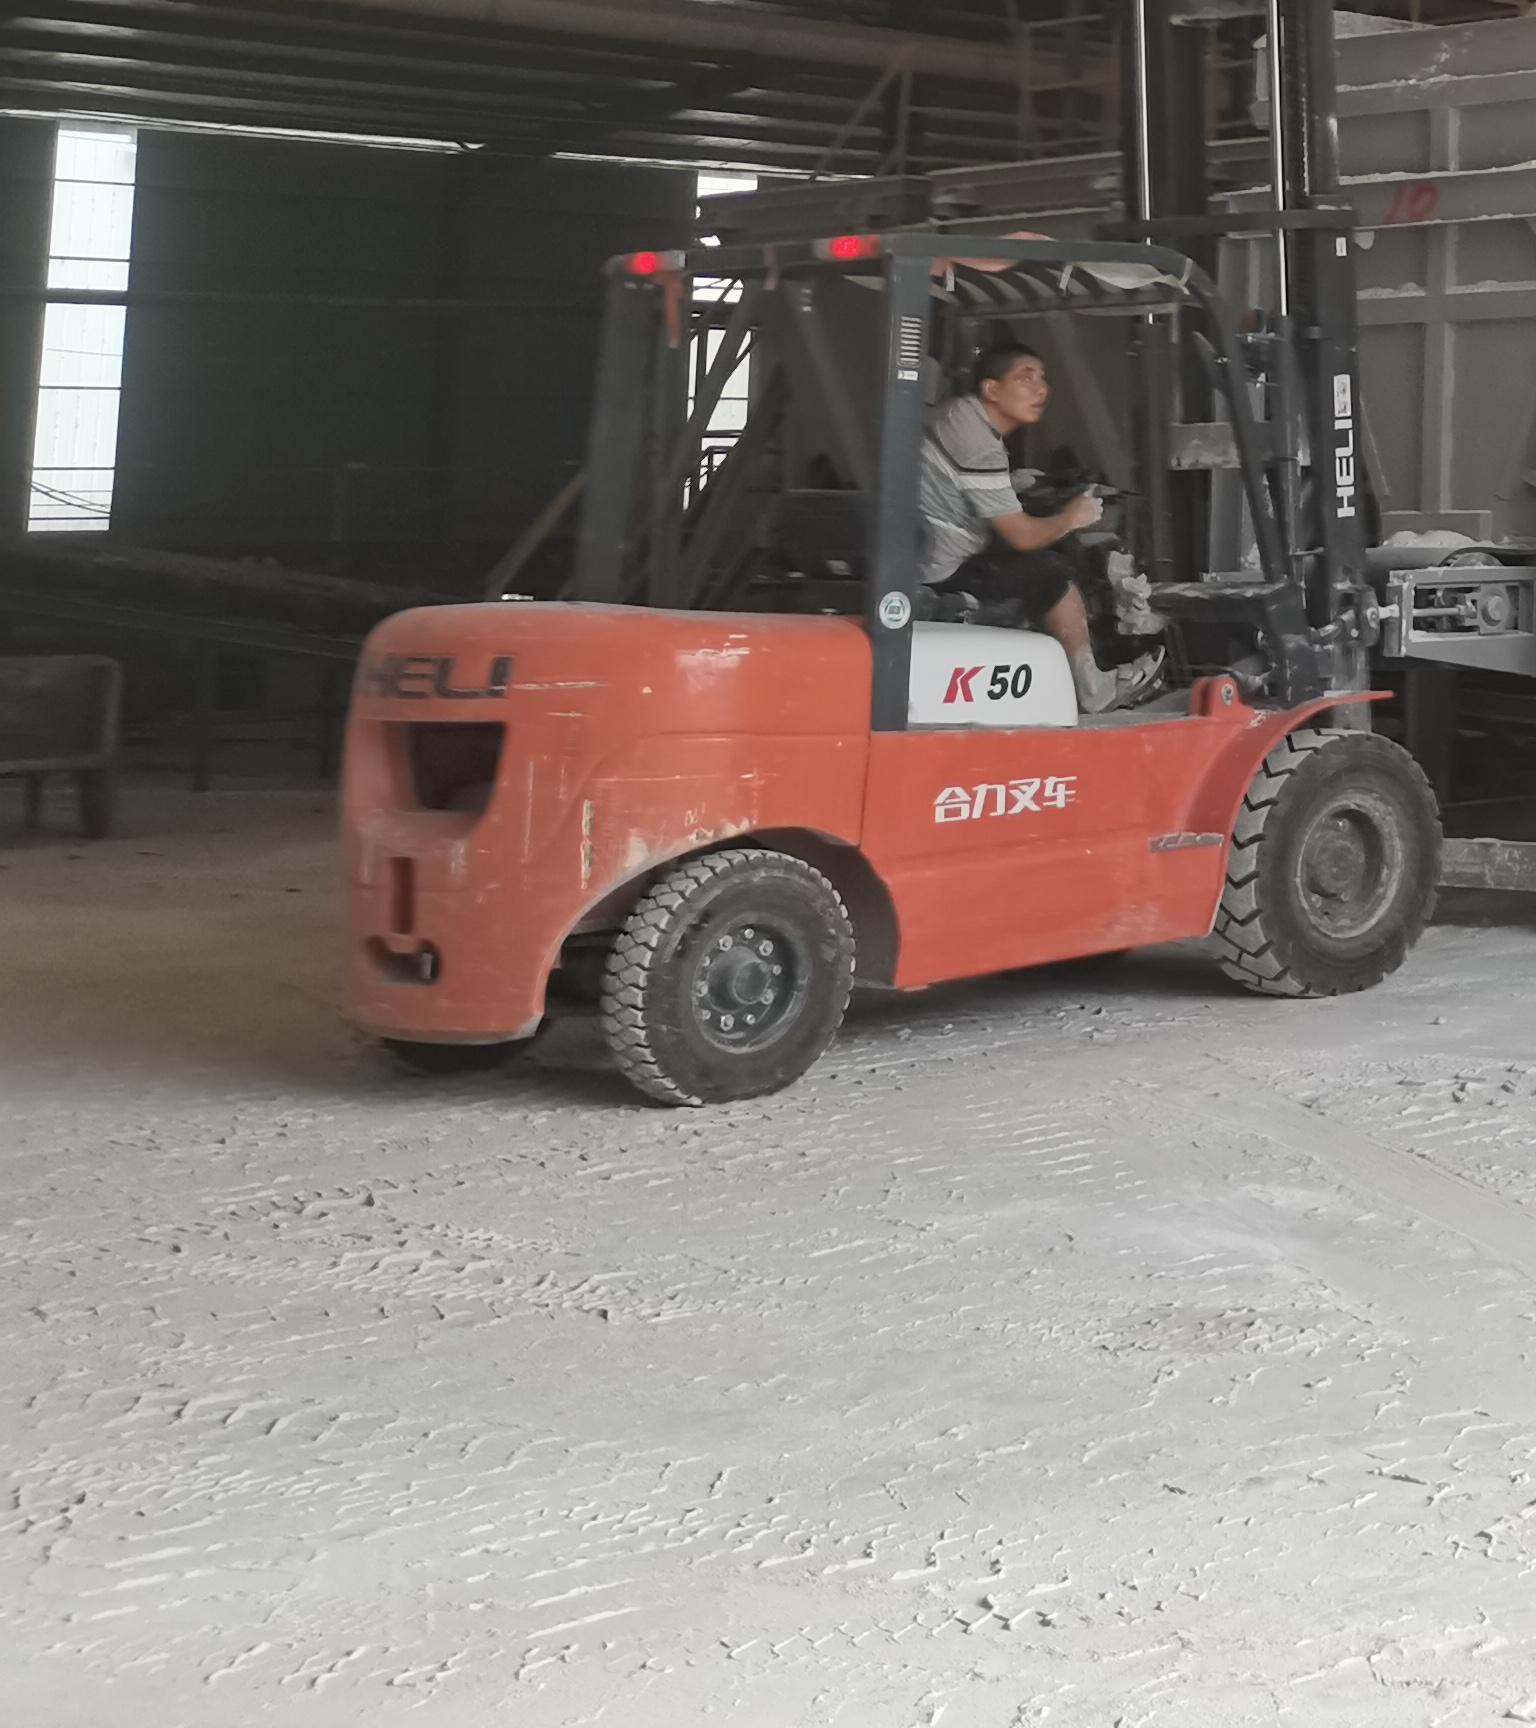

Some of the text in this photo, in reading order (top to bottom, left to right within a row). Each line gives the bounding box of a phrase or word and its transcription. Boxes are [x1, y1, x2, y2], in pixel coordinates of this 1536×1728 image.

[1384, 180, 1439, 225] 10
[1334, 418, 1355, 518] HELI
[943, 664, 1032, 704] K 50
[934, 775, 1078, 823] 合力叉车
